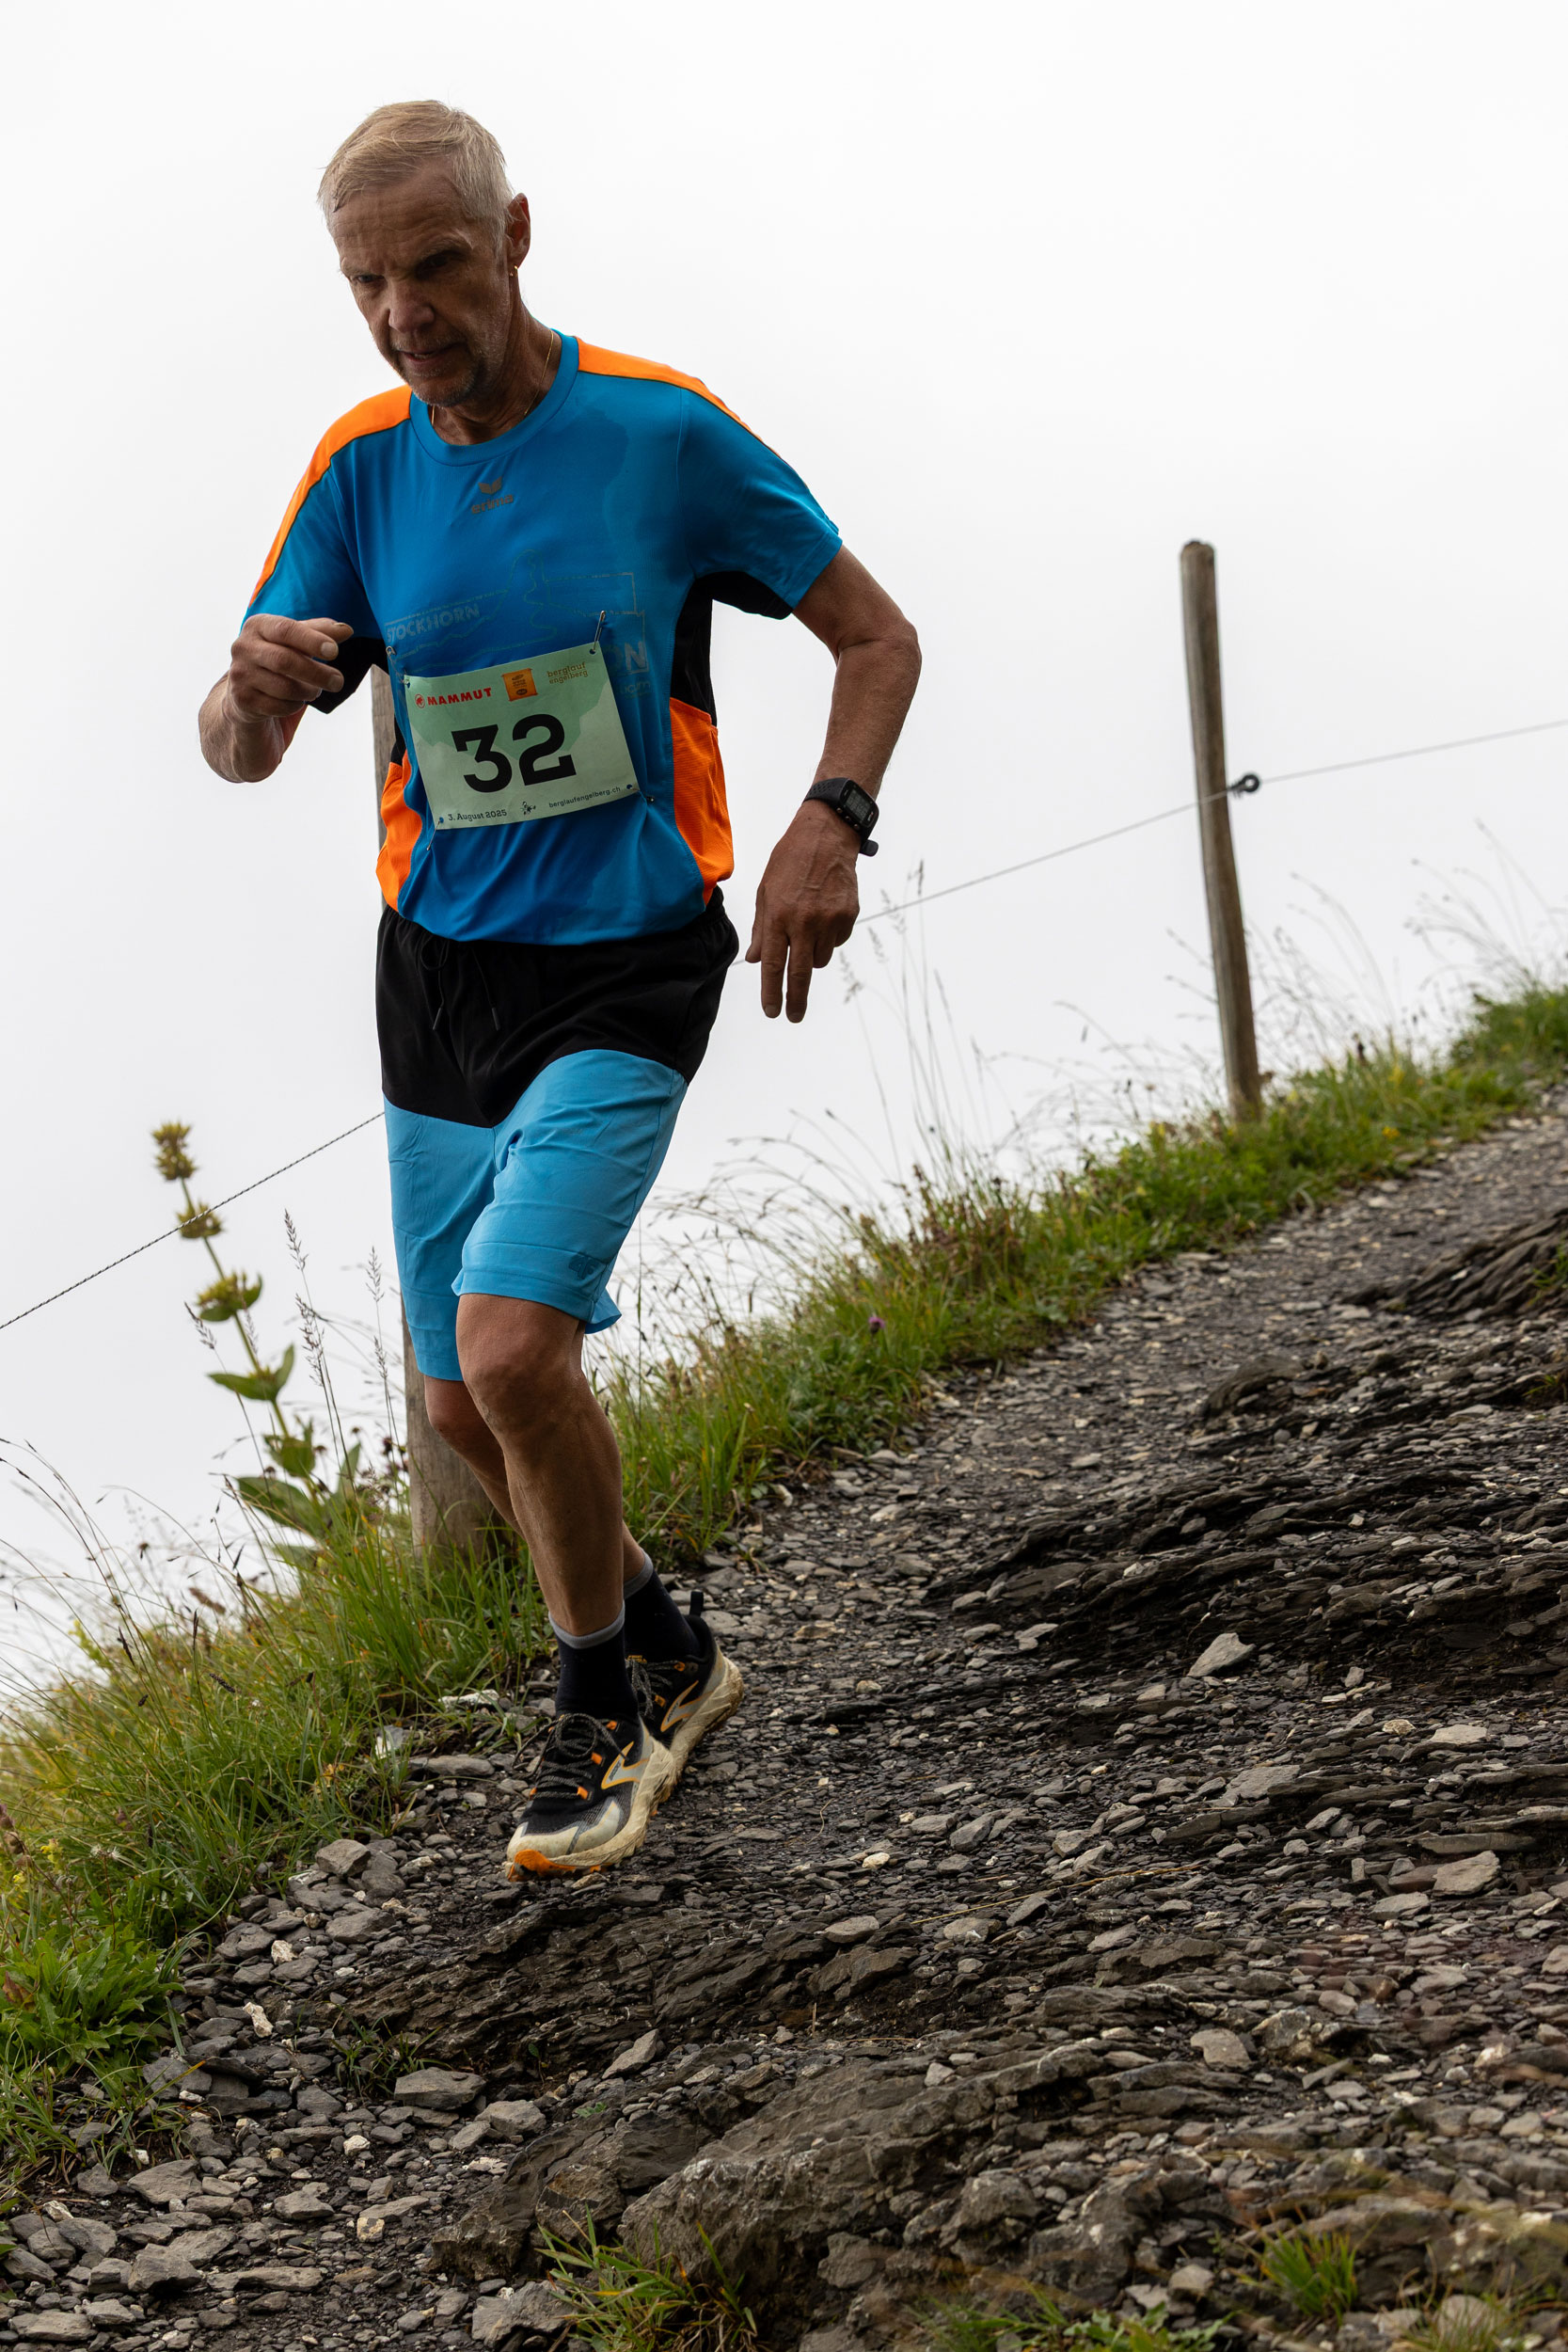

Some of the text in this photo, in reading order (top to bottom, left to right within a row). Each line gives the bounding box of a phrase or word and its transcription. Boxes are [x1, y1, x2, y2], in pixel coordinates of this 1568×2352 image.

[472, 494, 514, 514] erima
[387, 603, 481, 644] STOCKHORN
[546, 661, 586, 677] berglauf
[427, 687, 492, 706] MAMMUT
[451, 714, 577, 793] 32
[548, 787, 621, 807] berglaufengelberg.ch
[447, 809, 508, 822] 3. August 2025
